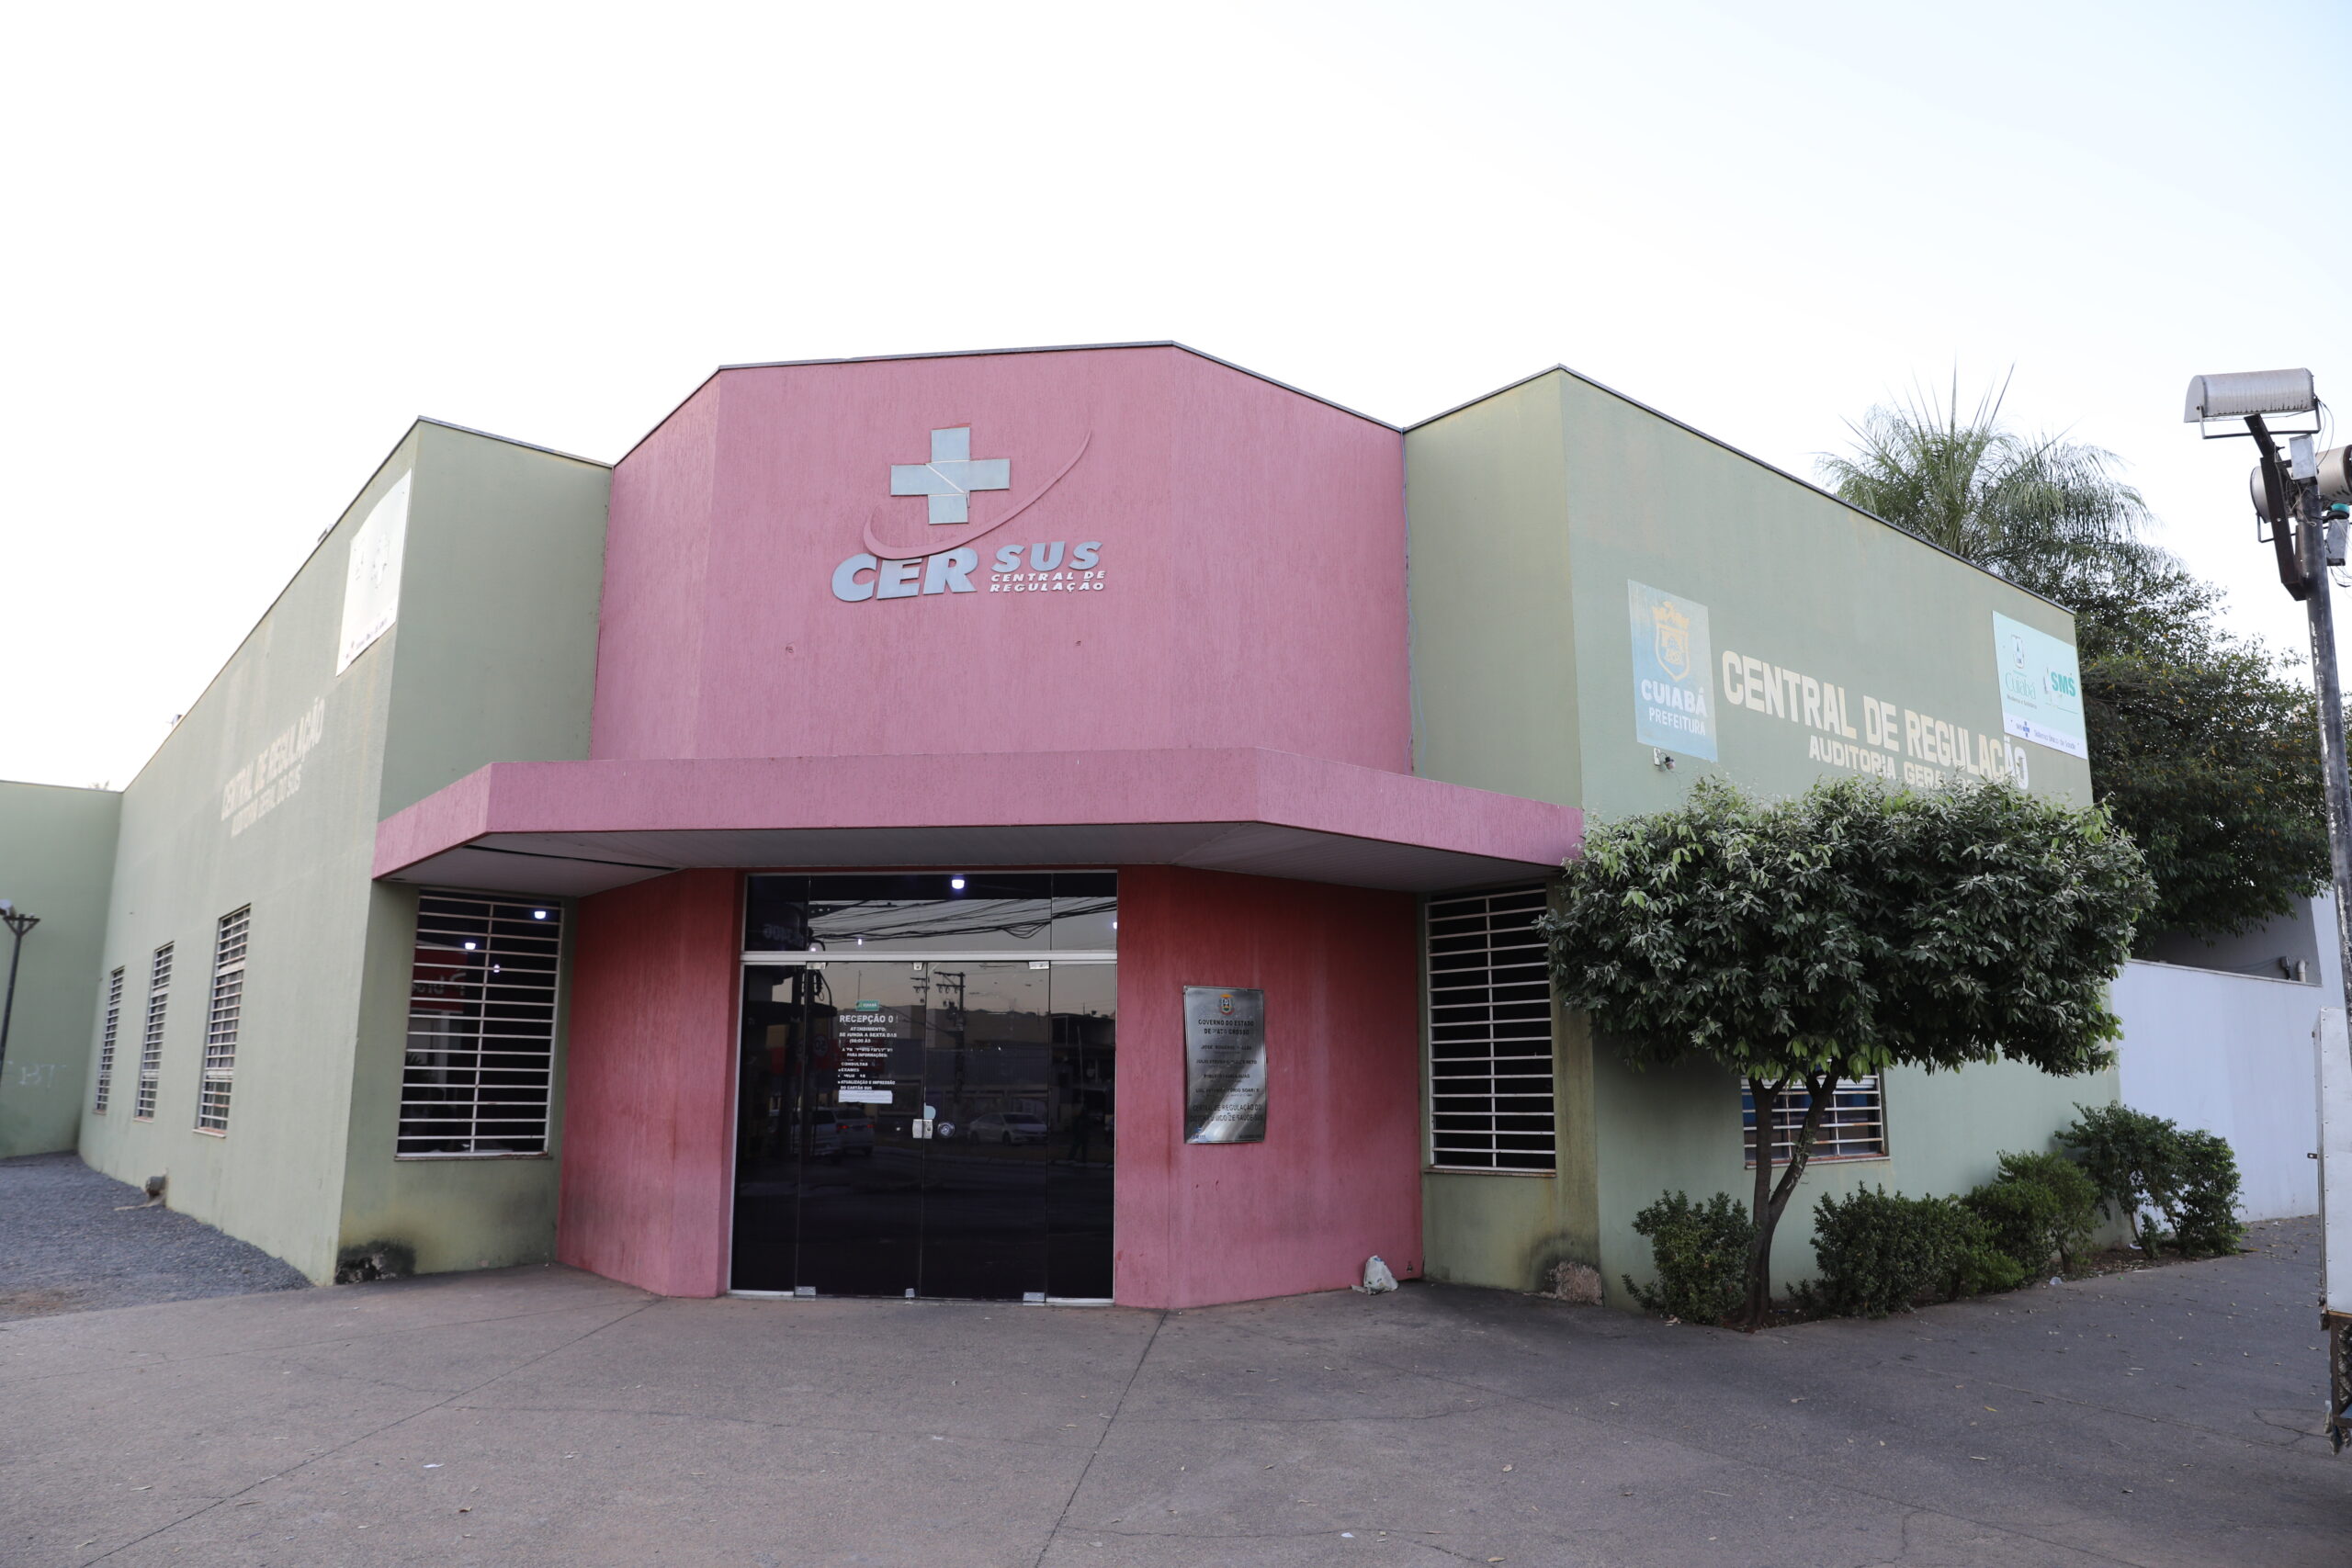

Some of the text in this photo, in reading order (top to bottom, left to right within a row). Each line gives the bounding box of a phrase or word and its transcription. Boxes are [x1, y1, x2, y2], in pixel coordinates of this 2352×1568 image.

[831, 541, 1102, 603] CER SUS
[989, 579, 1104, 592] REGULAÇÃO
[990, 570, 1105, 582] CENTRAL DE
[1641, 679, 1707, 717] CUIABÁ
[2050, 671, 2076, 697] SMS
[1722, 649, 1858, 740] CENTRAL
[1862, 695, 1900, 752] DE
[1648, 706, 1706, 736] PREFEITURA
[1809, 735, 1895, 780] AUDITORIA
[839, 1014, 886, 1025] RECEPÇÃO
